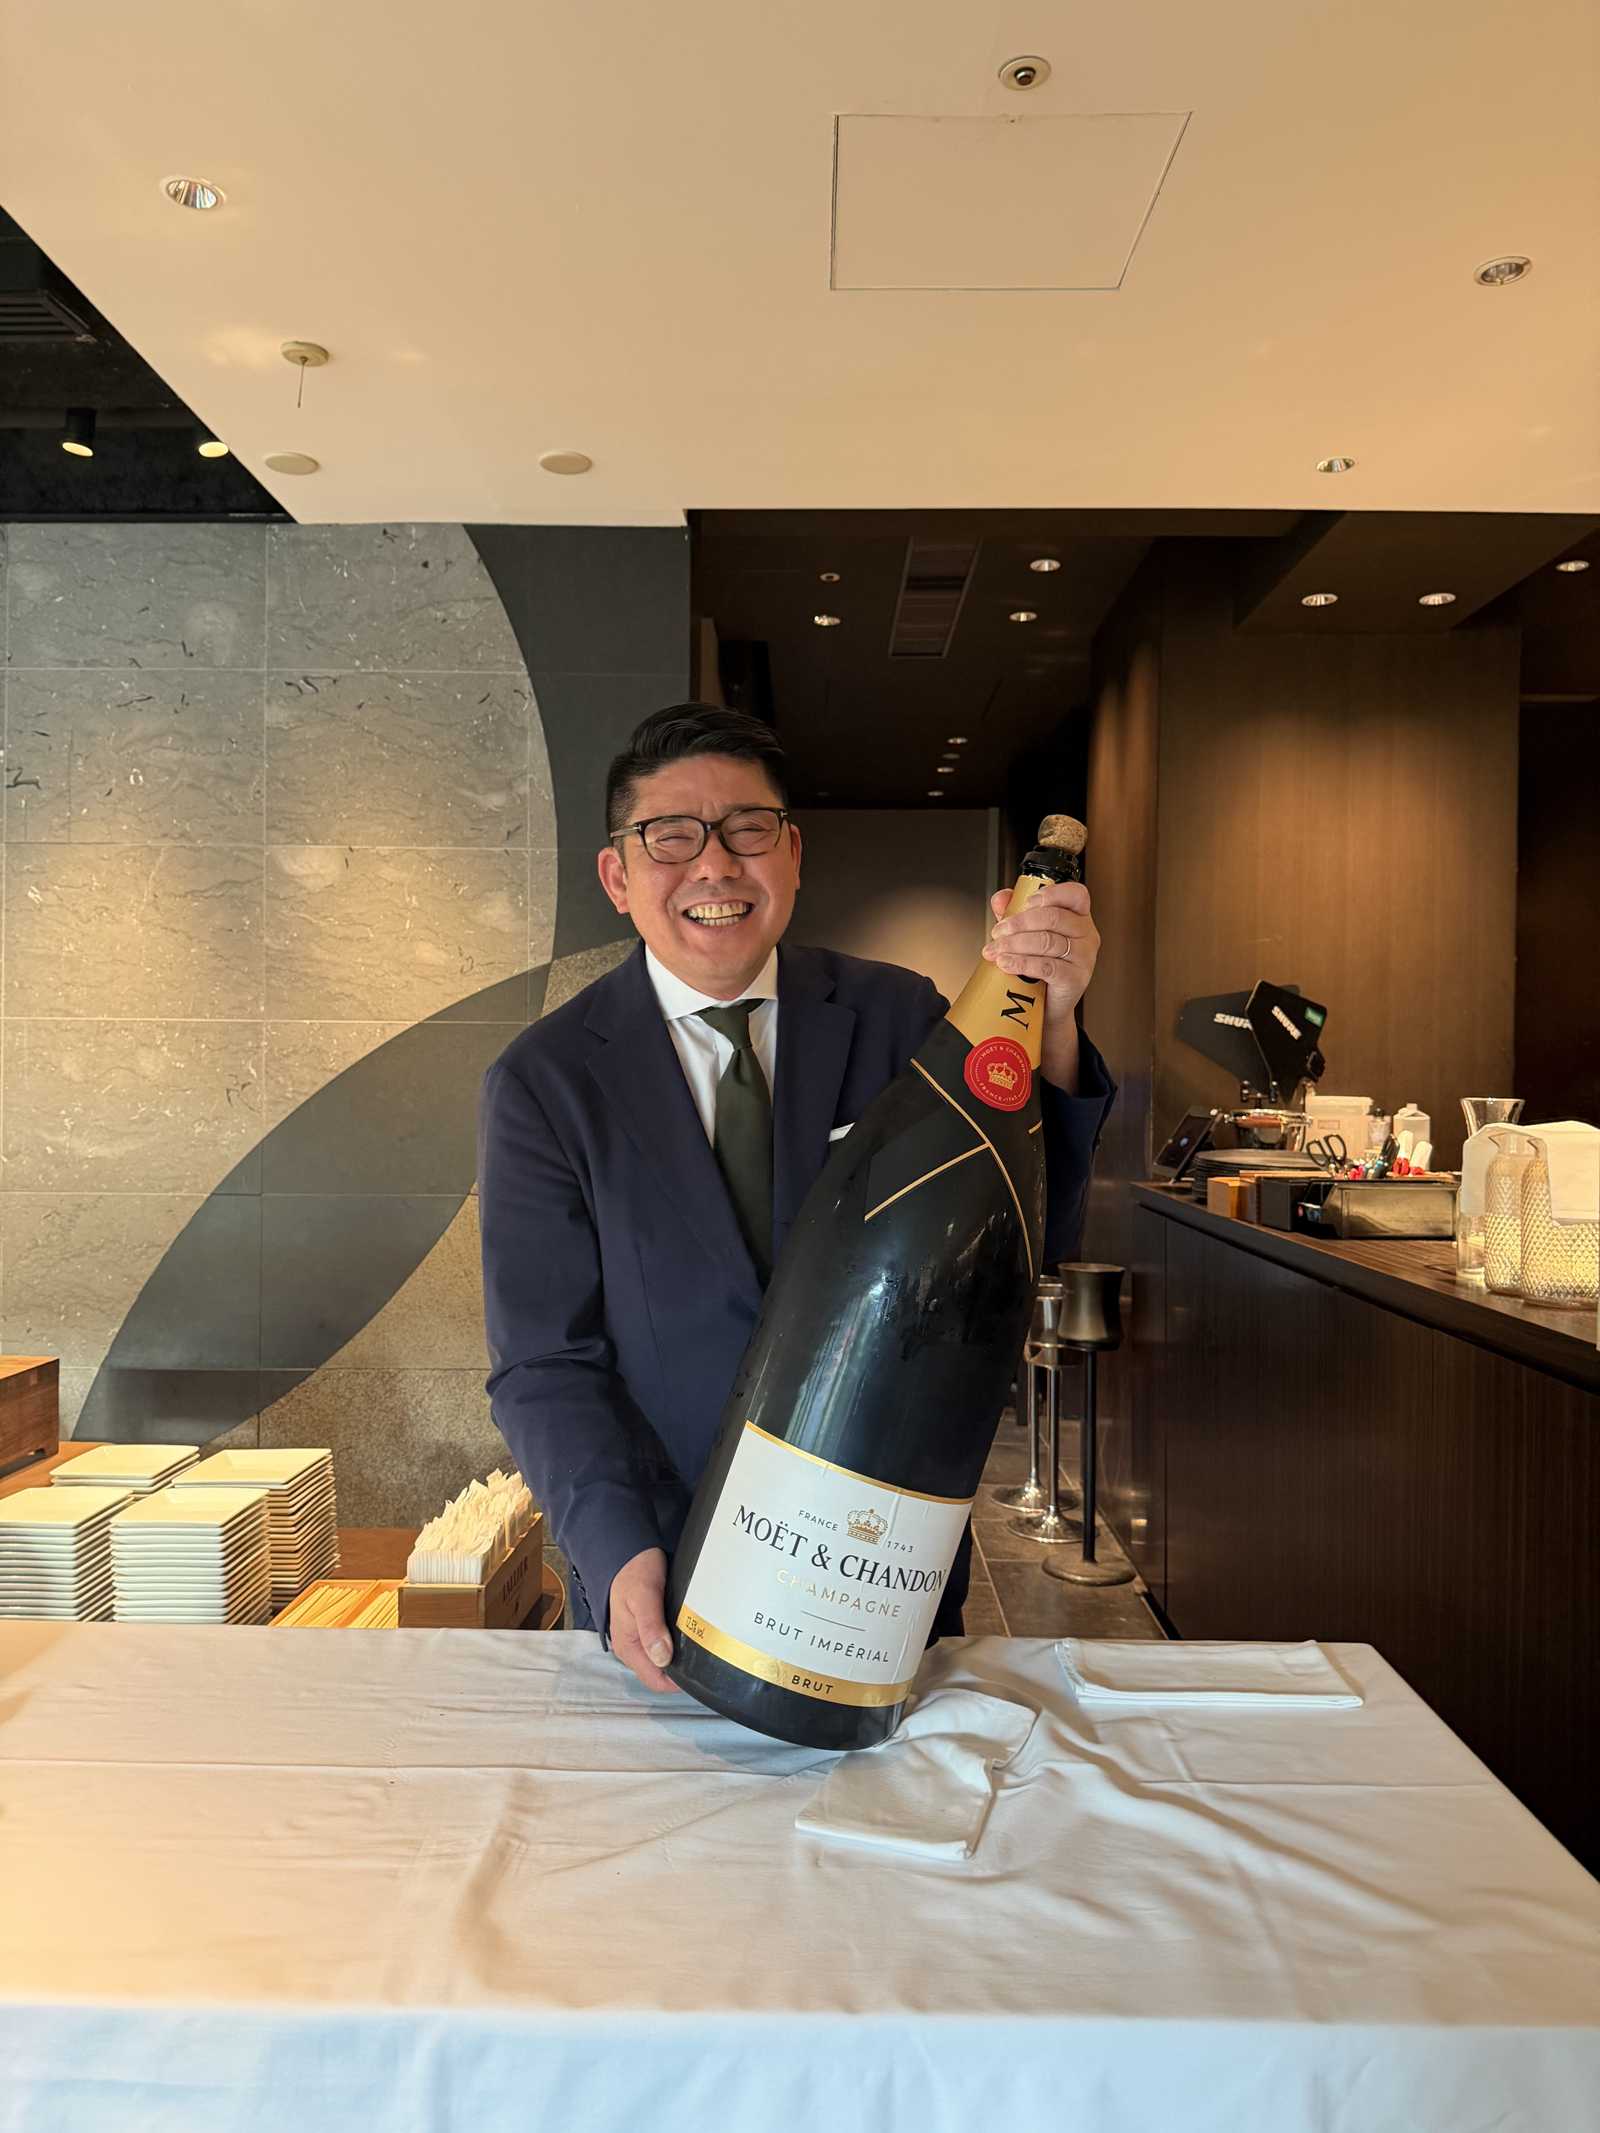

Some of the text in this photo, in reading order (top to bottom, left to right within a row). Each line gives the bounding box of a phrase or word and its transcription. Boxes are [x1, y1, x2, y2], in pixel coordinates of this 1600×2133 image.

[1000, 973, 1042, 1031] M
[1213, 1012, 1250, 1030] SHUR
[1271, 1005, 1302, 1040] SHURE
[798, 1510, 839, 1532] FRANCE
[732, 1505, 947, 1593] MOËT & CHANDON
[887, 1540, 914, 1553] 1743
[754, 1612, 889, 1663] BRUT IMPÉRIAL
[791, 1674, 834, 1694] BRUT
